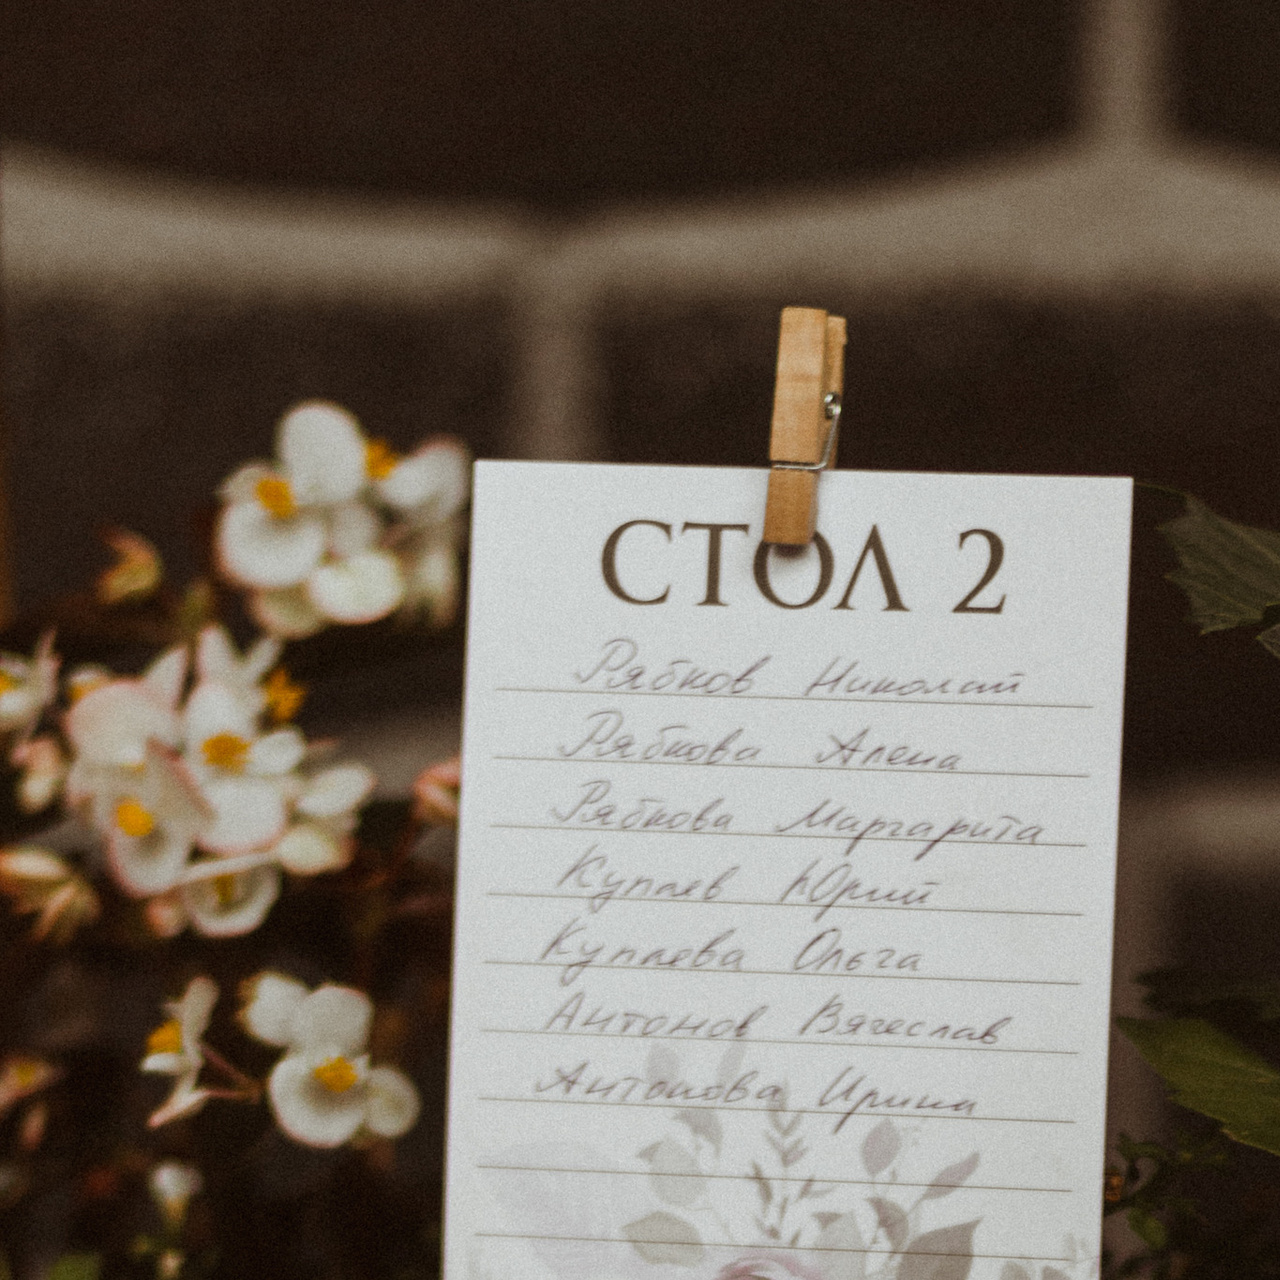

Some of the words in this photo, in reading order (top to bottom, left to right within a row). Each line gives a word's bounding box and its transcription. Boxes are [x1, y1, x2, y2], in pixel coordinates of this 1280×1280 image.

[601, 519, 911, 612] СТОЛ
[951, 527, 1008, 615] 2
[804, 655, 1025, 698] Николай
[815, 728, 964, 771] Алена
[774, 799, 1045, 862] Маргарита
[780, 860, 940, 922] Юрий
[792, 927, 924, 972] Ольга
[544, 991, 769, 1038] Антонов
[798, 993, 1014, 1045] Вячеслав
[533, 1060, 785, 1104] Антонова
[817, 1065, 978, 1135] Ирина
